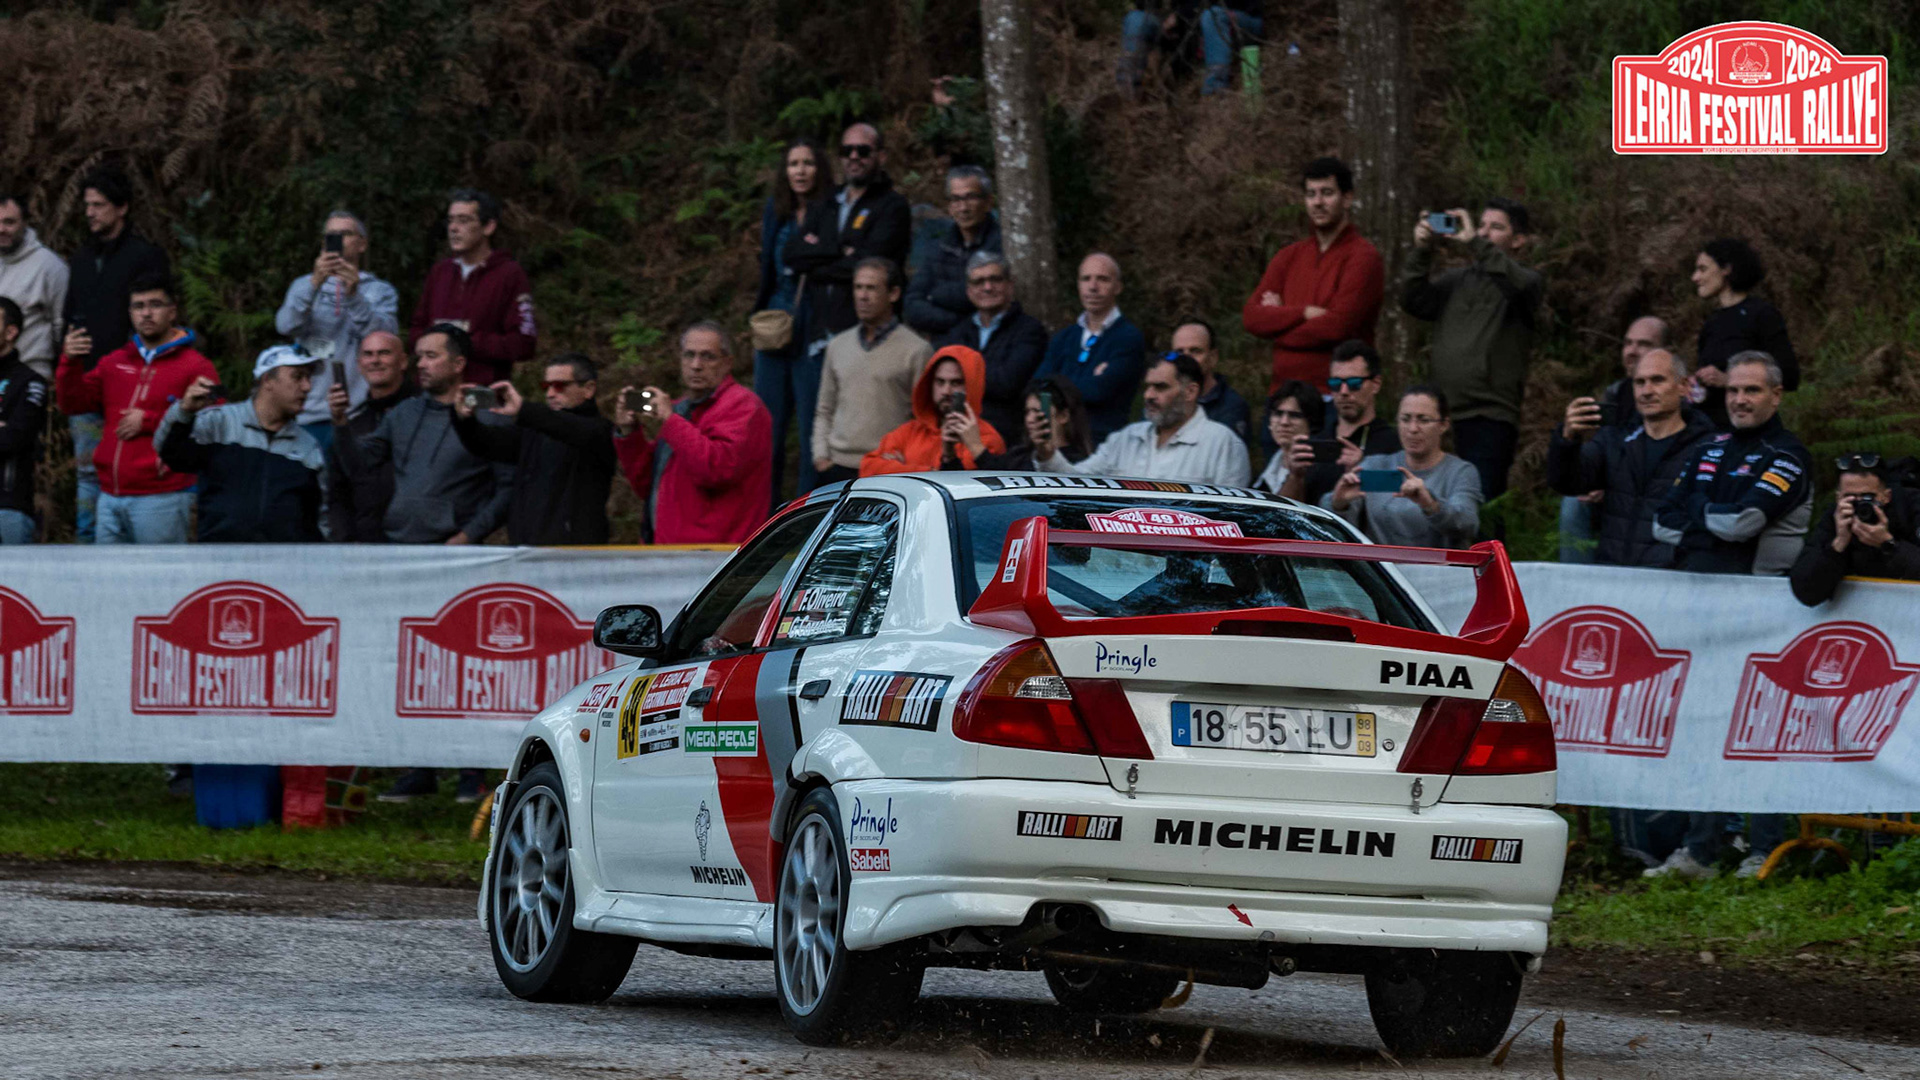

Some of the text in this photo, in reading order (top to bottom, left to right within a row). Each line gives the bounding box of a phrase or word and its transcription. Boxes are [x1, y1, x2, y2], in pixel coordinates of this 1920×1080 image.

[998, 476, 1122, 489] RALLI
[1117, 511, 1144, 523] 2024
[1150, 514, 1175, 524] 49
[12, 626, 68, 705] RALLYE
[138, 626, 334, 707] LEIRIA FESTIVAL RALLYE
[404, 628, 458, 708] LEIRIA
[462, 655, 539, 711] FESTIVAL
[1095, 641, 1157, 674] Pringle
[1380, 660, 1474, 690] PIAA
[622, 677, 650, 754] 49
[843, 674, 946, 725] RALLI ART
[1610, 661, 1684, 747] RALLYE
[1733, 664, 1916, 751] LEIRIA FESTIVAL RALLYE
[1178, 728, 1185, 738] P
[1357, 718, 1371, 731] 98
[850, 796, 898, 845] Pringle
[1022, 812, 1118, 839] RALLI ART
[1154, 818, 1396, 858] MICHELIN
[1435, 836, 1520, 862] RALLI ART
[690, 866, 747, 886] MICHELIN
[851, 849, 890, 870] Sabelt
